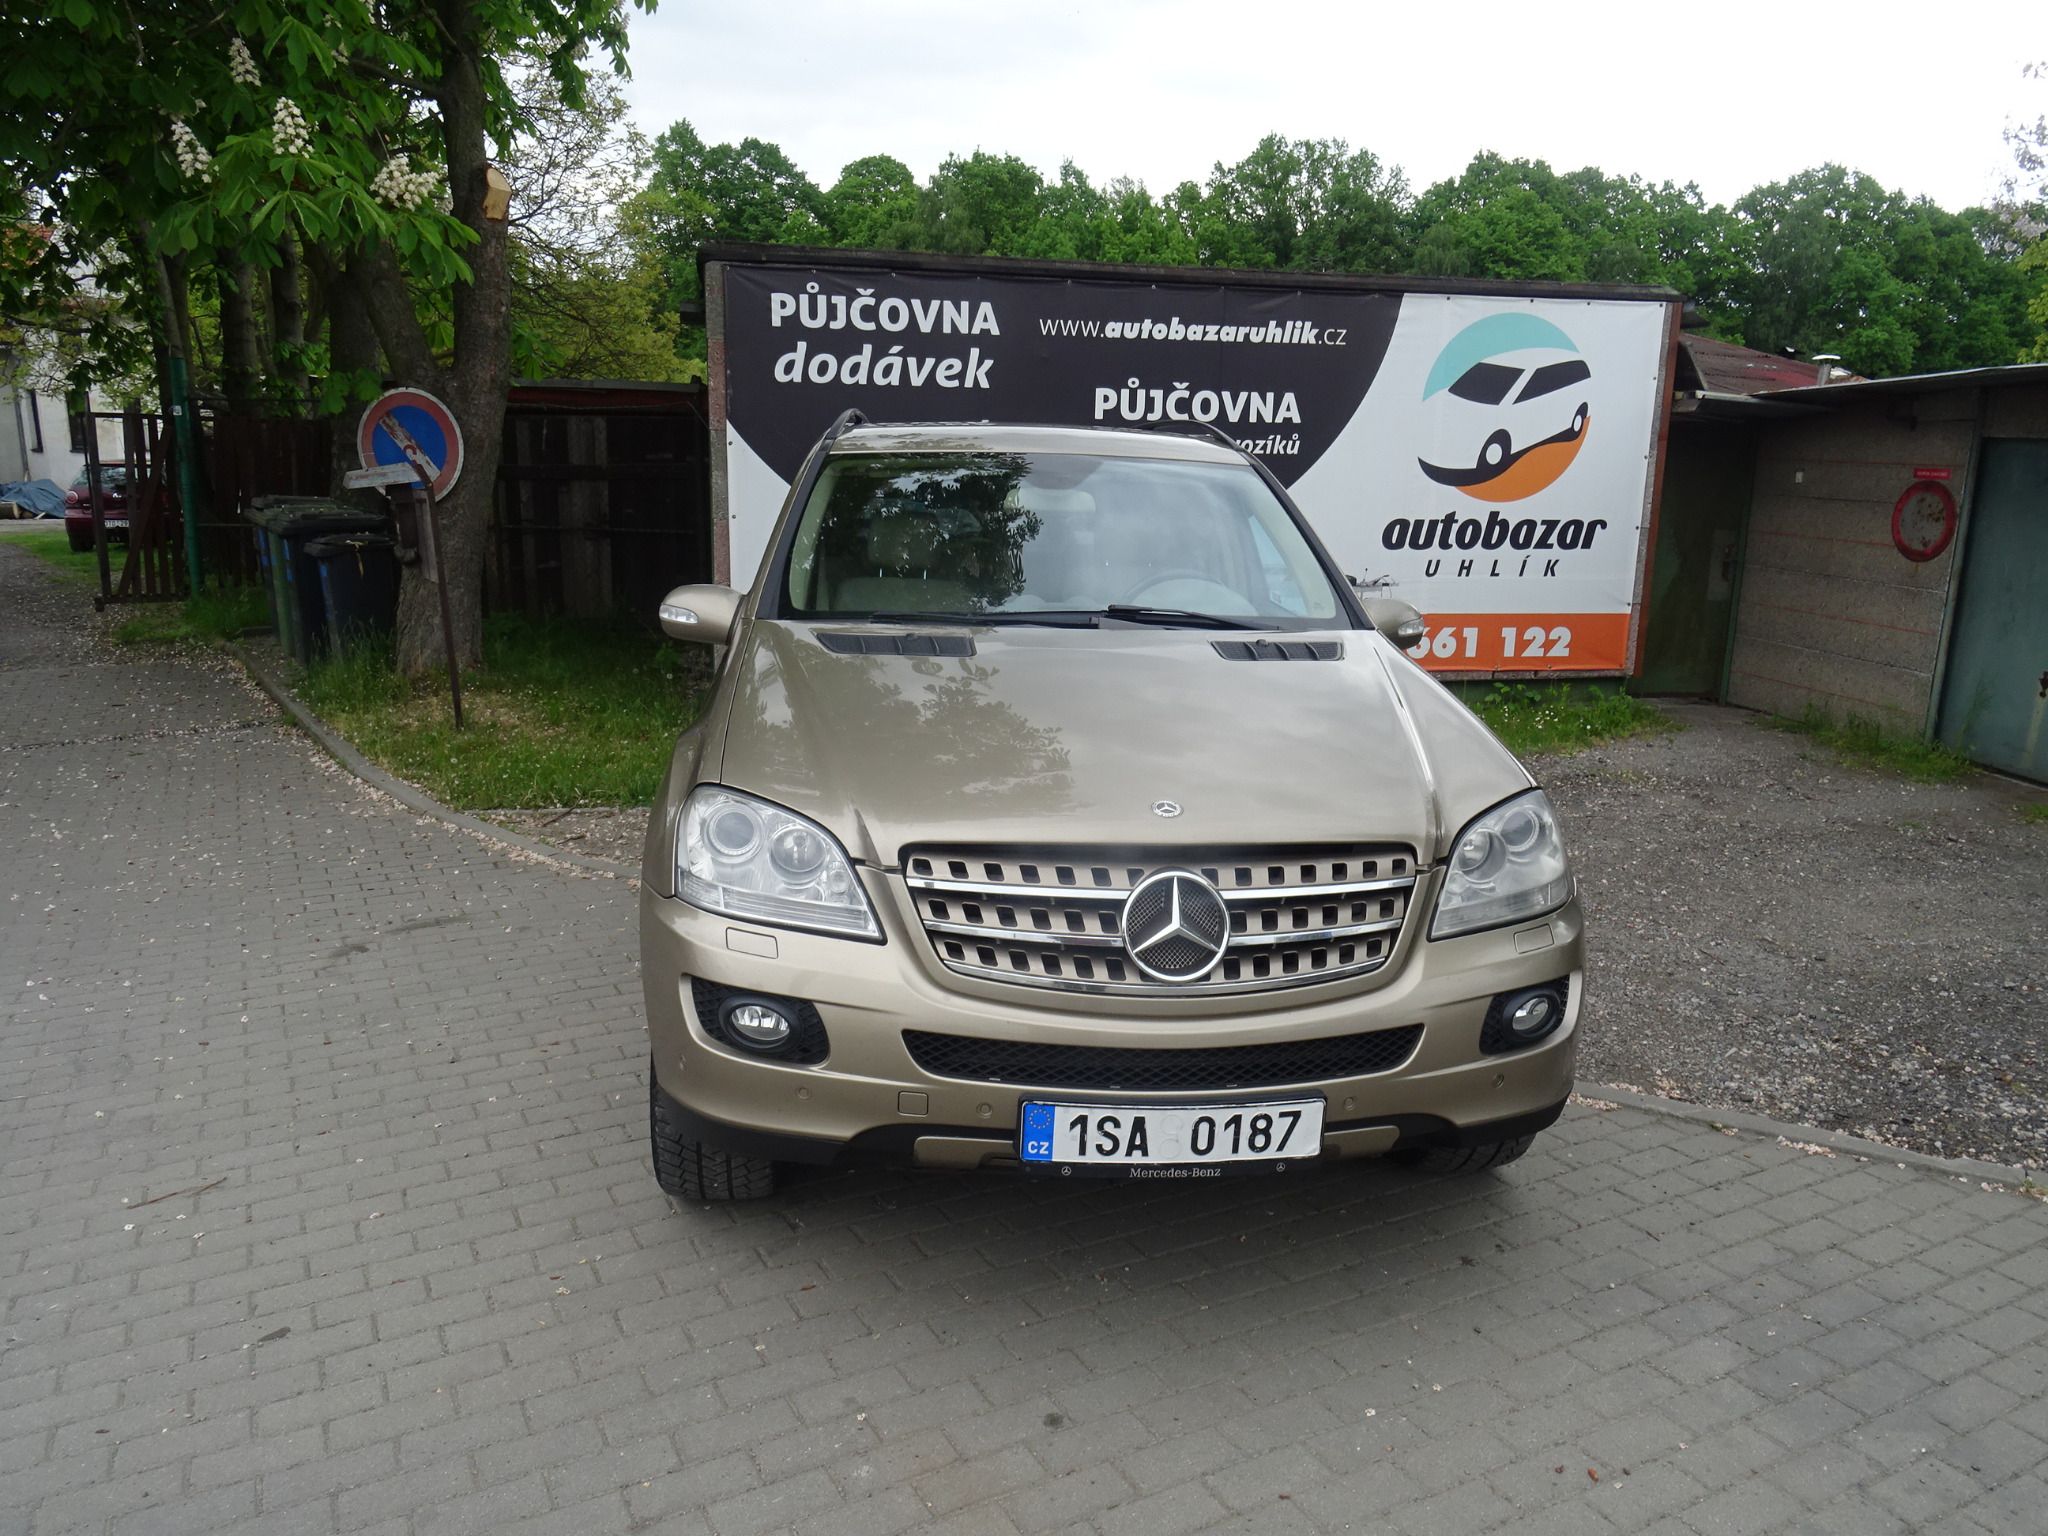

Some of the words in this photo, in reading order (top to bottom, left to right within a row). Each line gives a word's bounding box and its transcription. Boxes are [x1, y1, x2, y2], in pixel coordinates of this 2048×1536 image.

[771, 281, 1001, 336] PŮJČOVNA
[1039, 317, 1348, 345] www.autobazaruhlik.cz
[774, 341, 994, 389] dodávek
[1094, 377, 1301, 424] PŮJČOVNA
[1381, 510, 1608, 551] autobazar
[1424, 554, 1560, 578] UHLÍK
[1501, 626, 1572, 658] 122
[1027, 1141, 1049, 1155] CZ
[1068, 1114, 1149, 1158] 1SA
[1190, 1110, 1302, 1157] 0187
[1129, 1167, 1221, 1178] Mercedes-Benz
